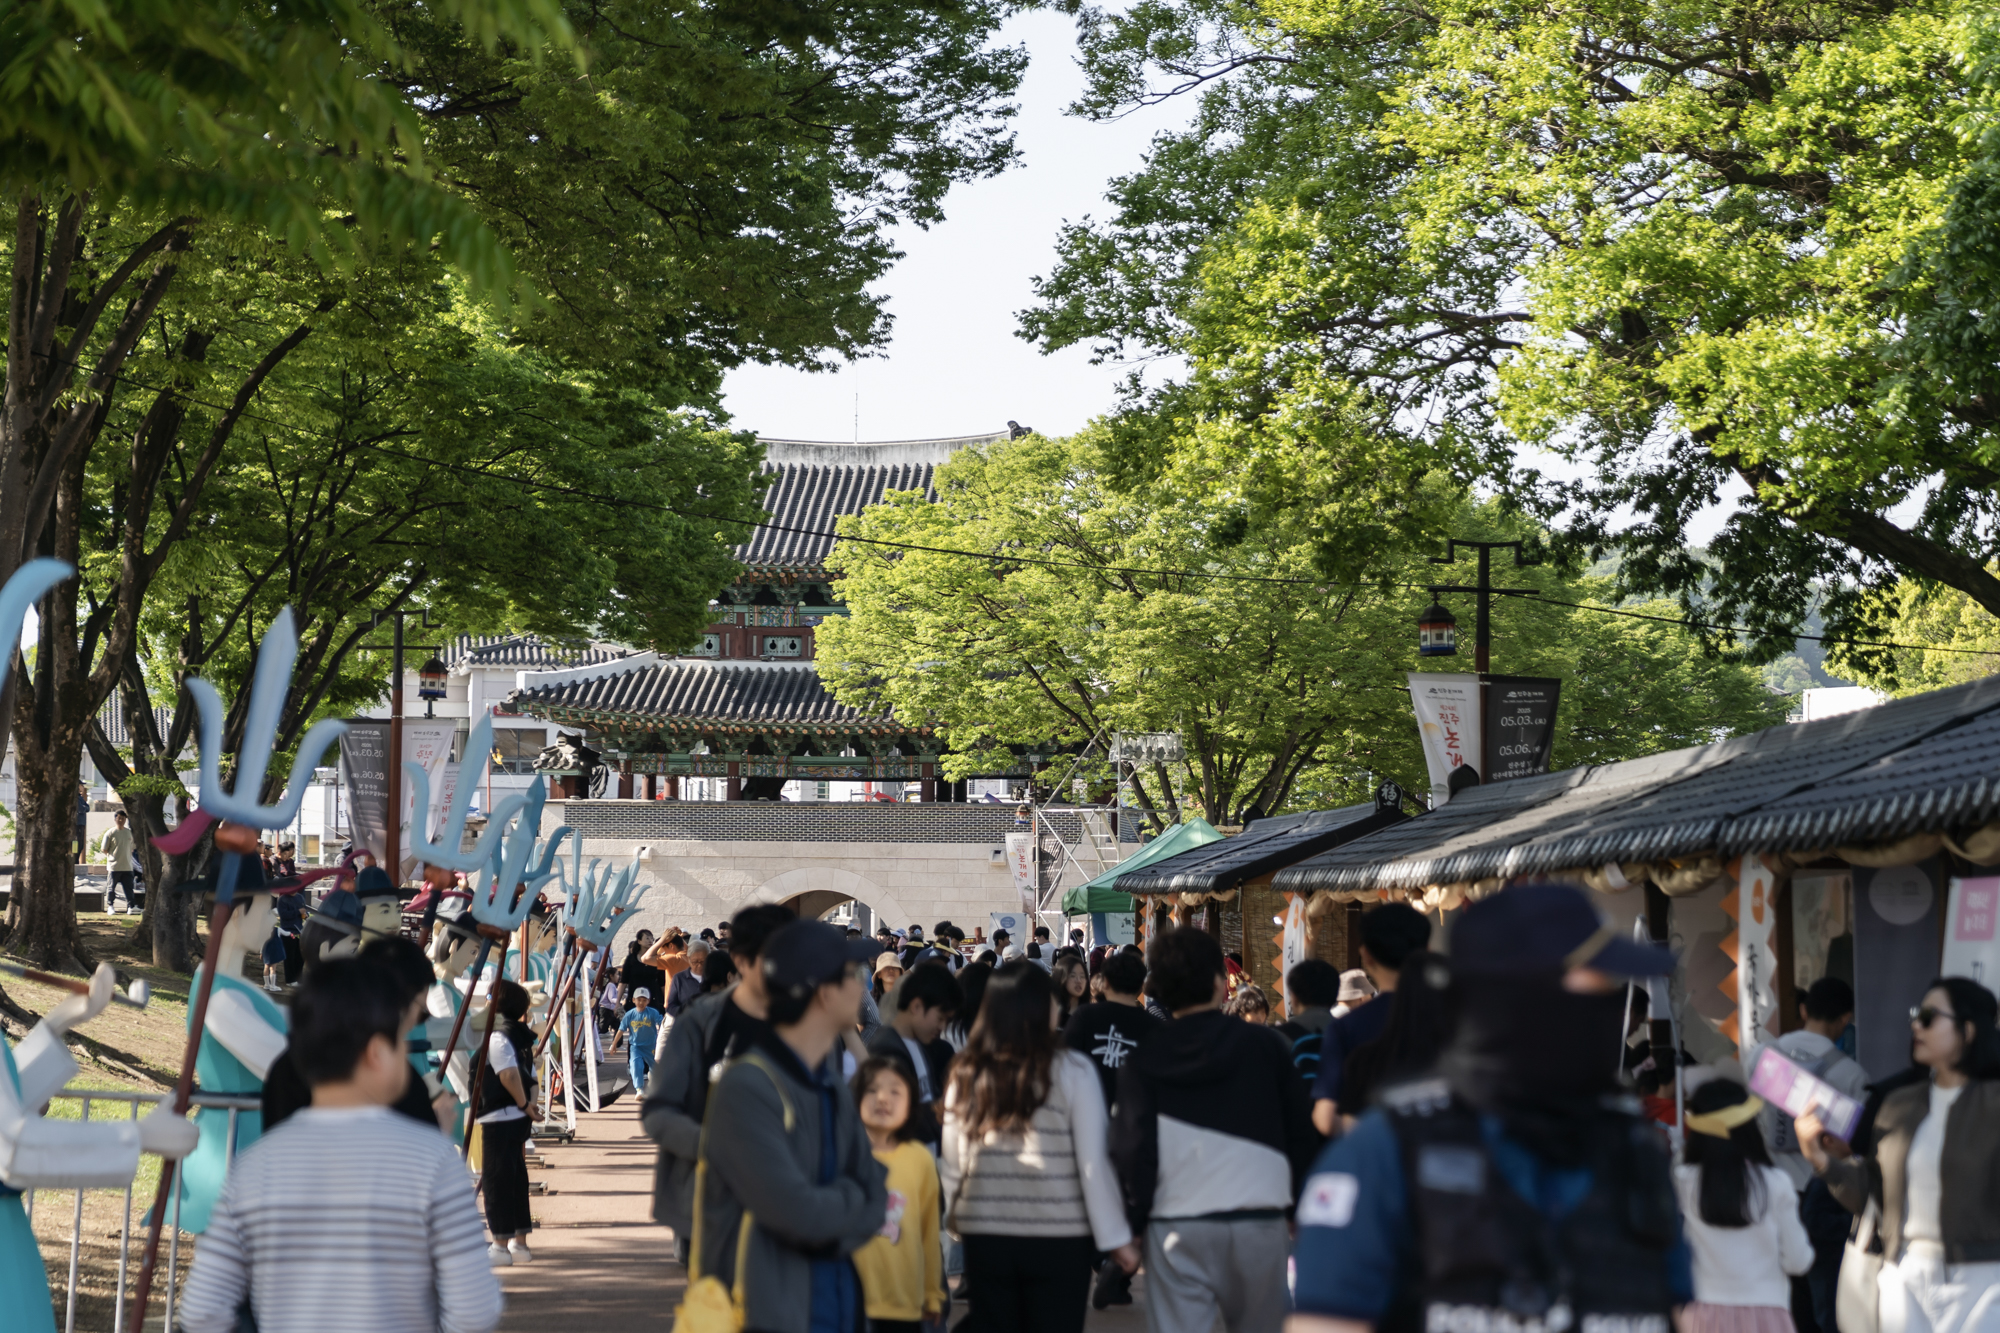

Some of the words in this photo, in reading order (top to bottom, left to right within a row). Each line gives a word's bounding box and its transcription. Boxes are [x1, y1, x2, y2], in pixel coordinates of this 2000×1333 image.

[1438, 712, 1460, 726] 진주
[1500, 715, 1534, 727] 05.03.
[1499, 743, 1532, 757] 05.06.
[1381, 784, 1398, 801] 福
